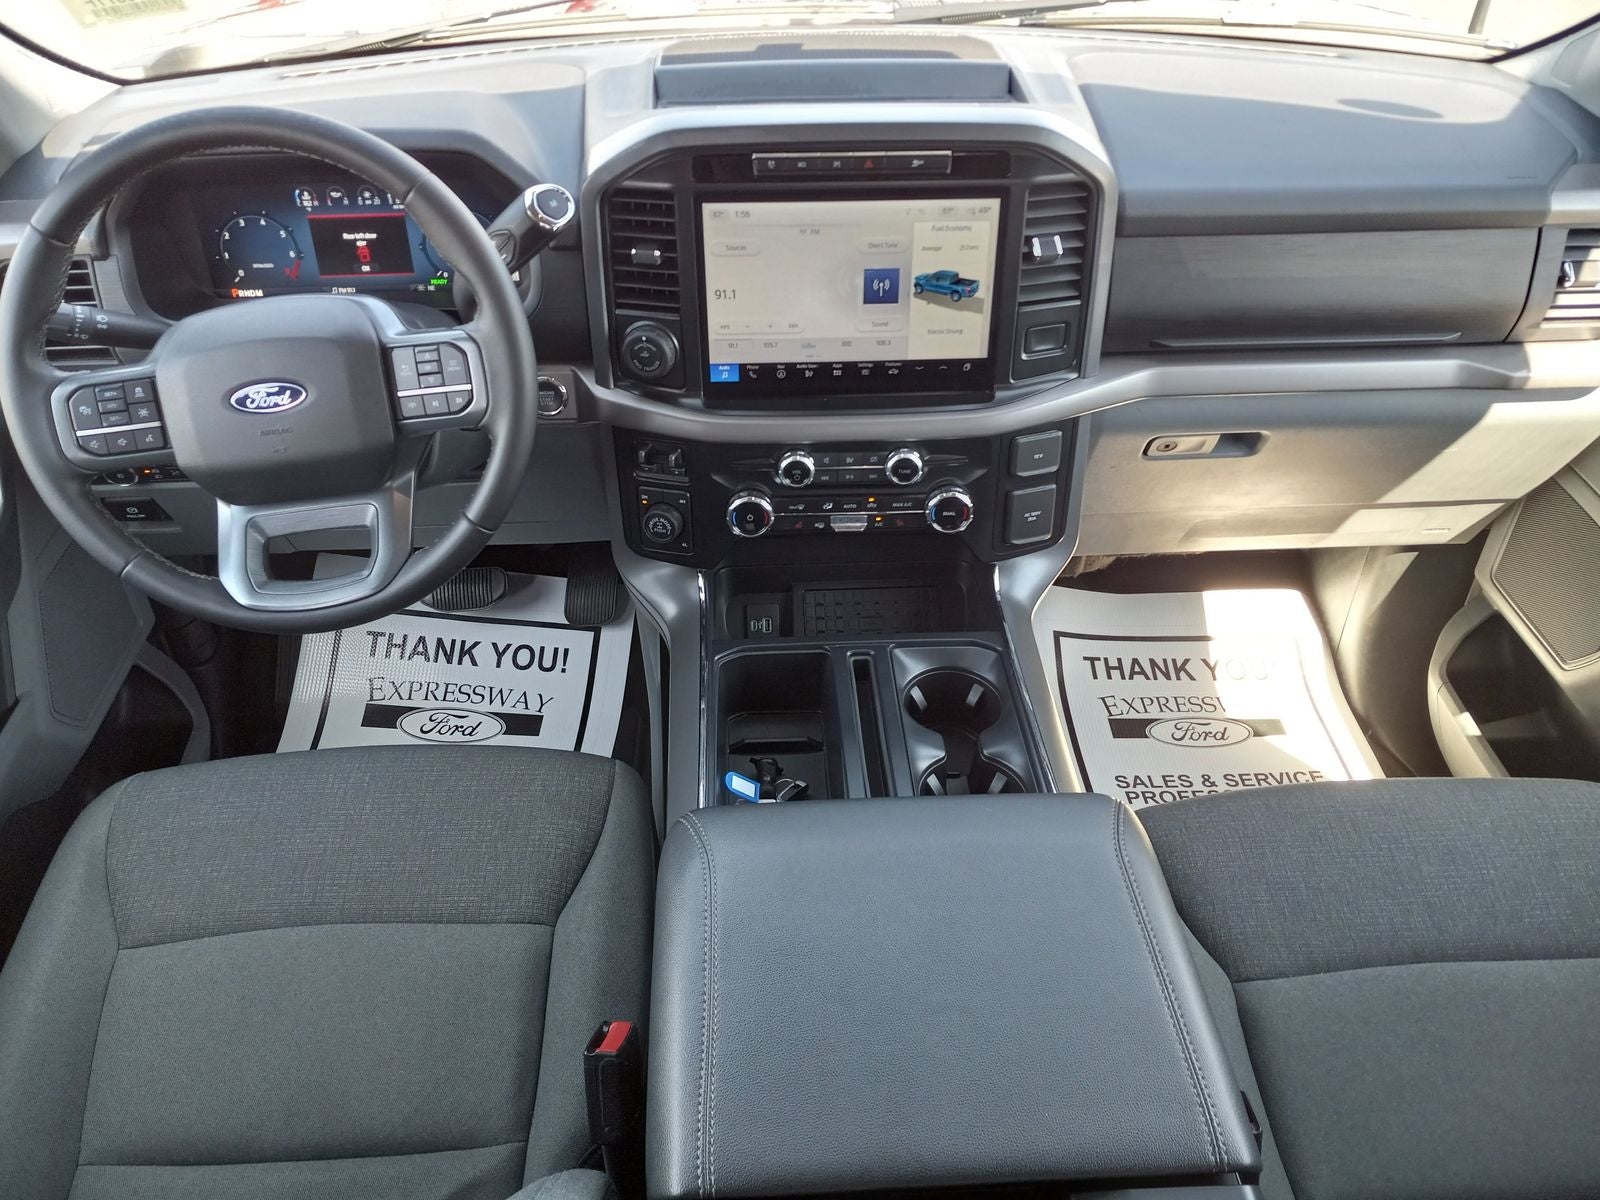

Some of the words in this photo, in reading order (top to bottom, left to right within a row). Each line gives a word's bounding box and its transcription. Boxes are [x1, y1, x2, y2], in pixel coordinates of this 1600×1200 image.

[223, 231, 230, 240] 2
[279, 230, 286, 238] 5
[289, 250, 296, 258] 6
[714, 289, 736, 300] 91.1
[246, 386, 292, 409] Ford
[366, 630, 483, 667] THANK
[490, 641, 570, 674] YOU!
[1082, 655, 1195, 681] THANK
[366, 676, 555, 714] EXPRESSWAY
[419, 711, 483, 738] Ford
[1171, 721, 1230, 743] Ford
[1114, 774, 1194, 789] SALES
[1201, 773, 1218, 788] &
[1225, 770, 1323, 787] SERVICE
